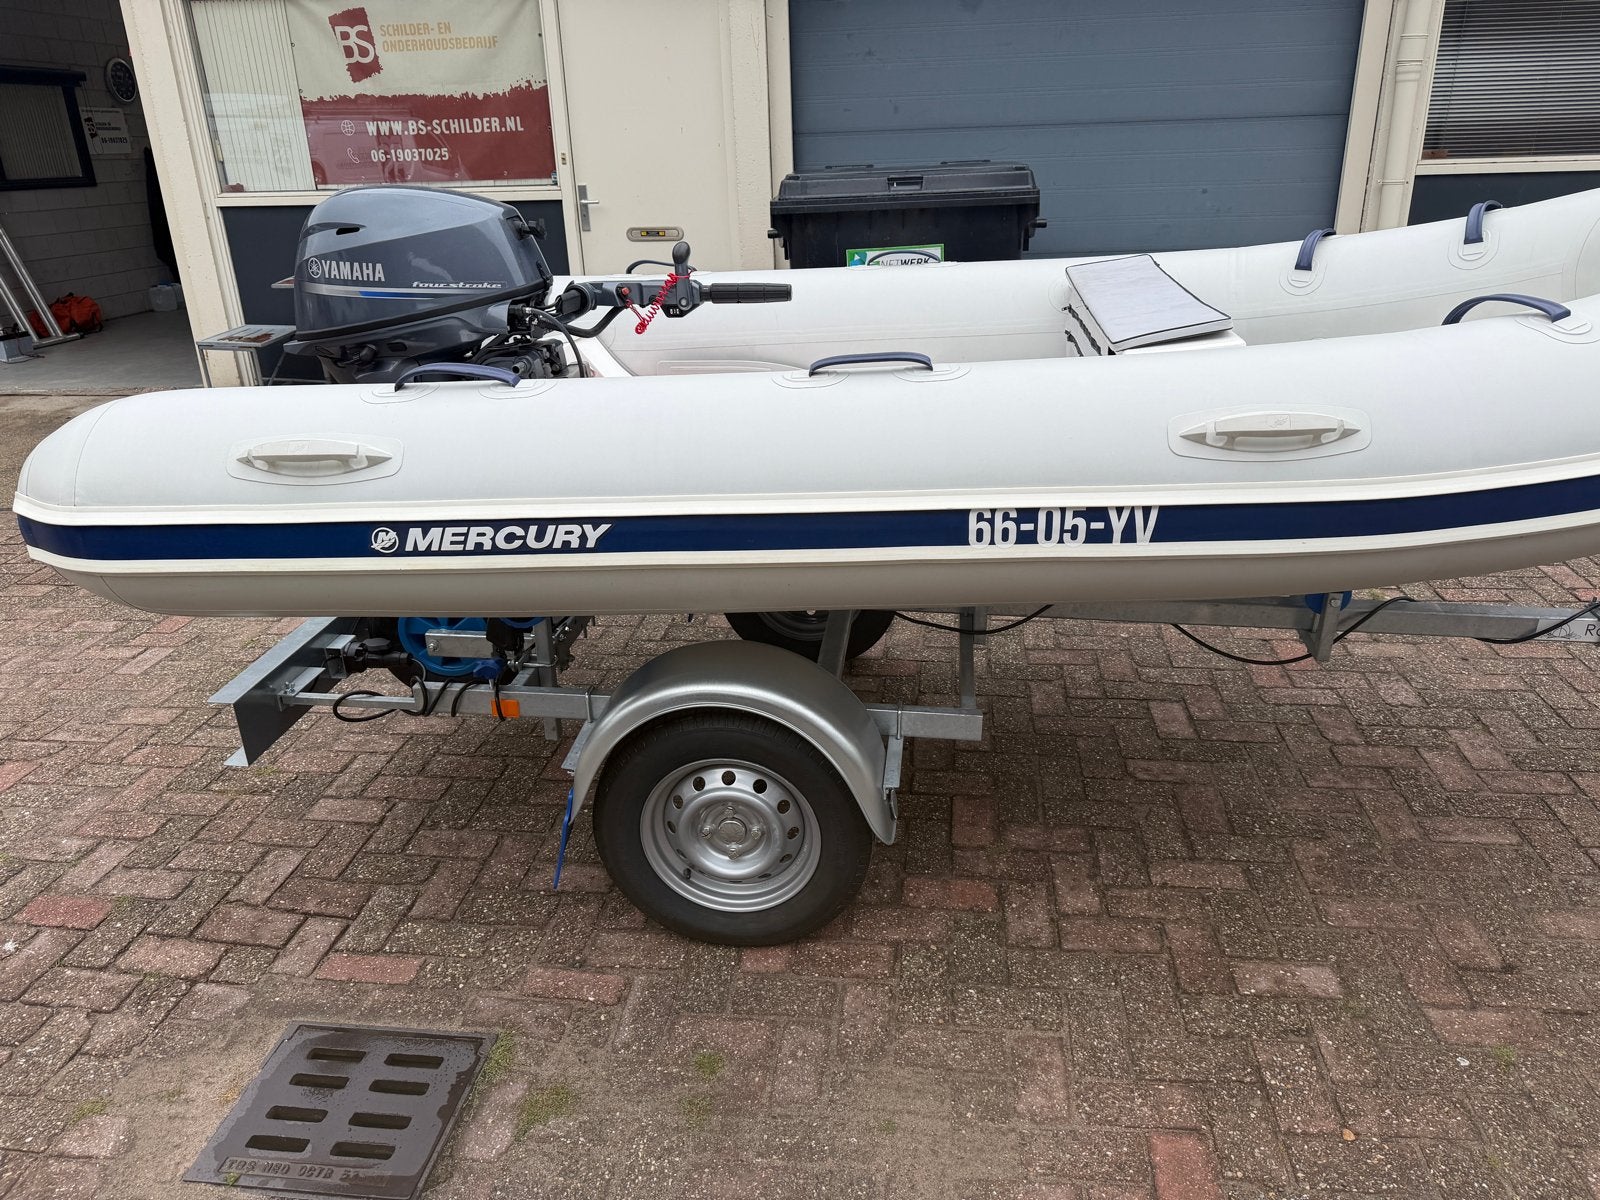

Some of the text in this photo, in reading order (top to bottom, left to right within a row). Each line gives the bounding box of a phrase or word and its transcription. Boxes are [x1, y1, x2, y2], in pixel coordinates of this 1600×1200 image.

[379, 22, 452, 37] SCHILDER- EN
[335, 25, 375, 64] BS
[382, 36, 498, 53] ONDERHOUDSBEDRIJF
[365, 116, 524, 136] WWW.BS-SCHILDER.NL
[370, 147, 449, 162] 06-19037025
[321, 260, 385, 282] YAMAHA
[404, 523, 612, 551] MERCURY
[968, 506, 1159, 549] 66-05-YV
